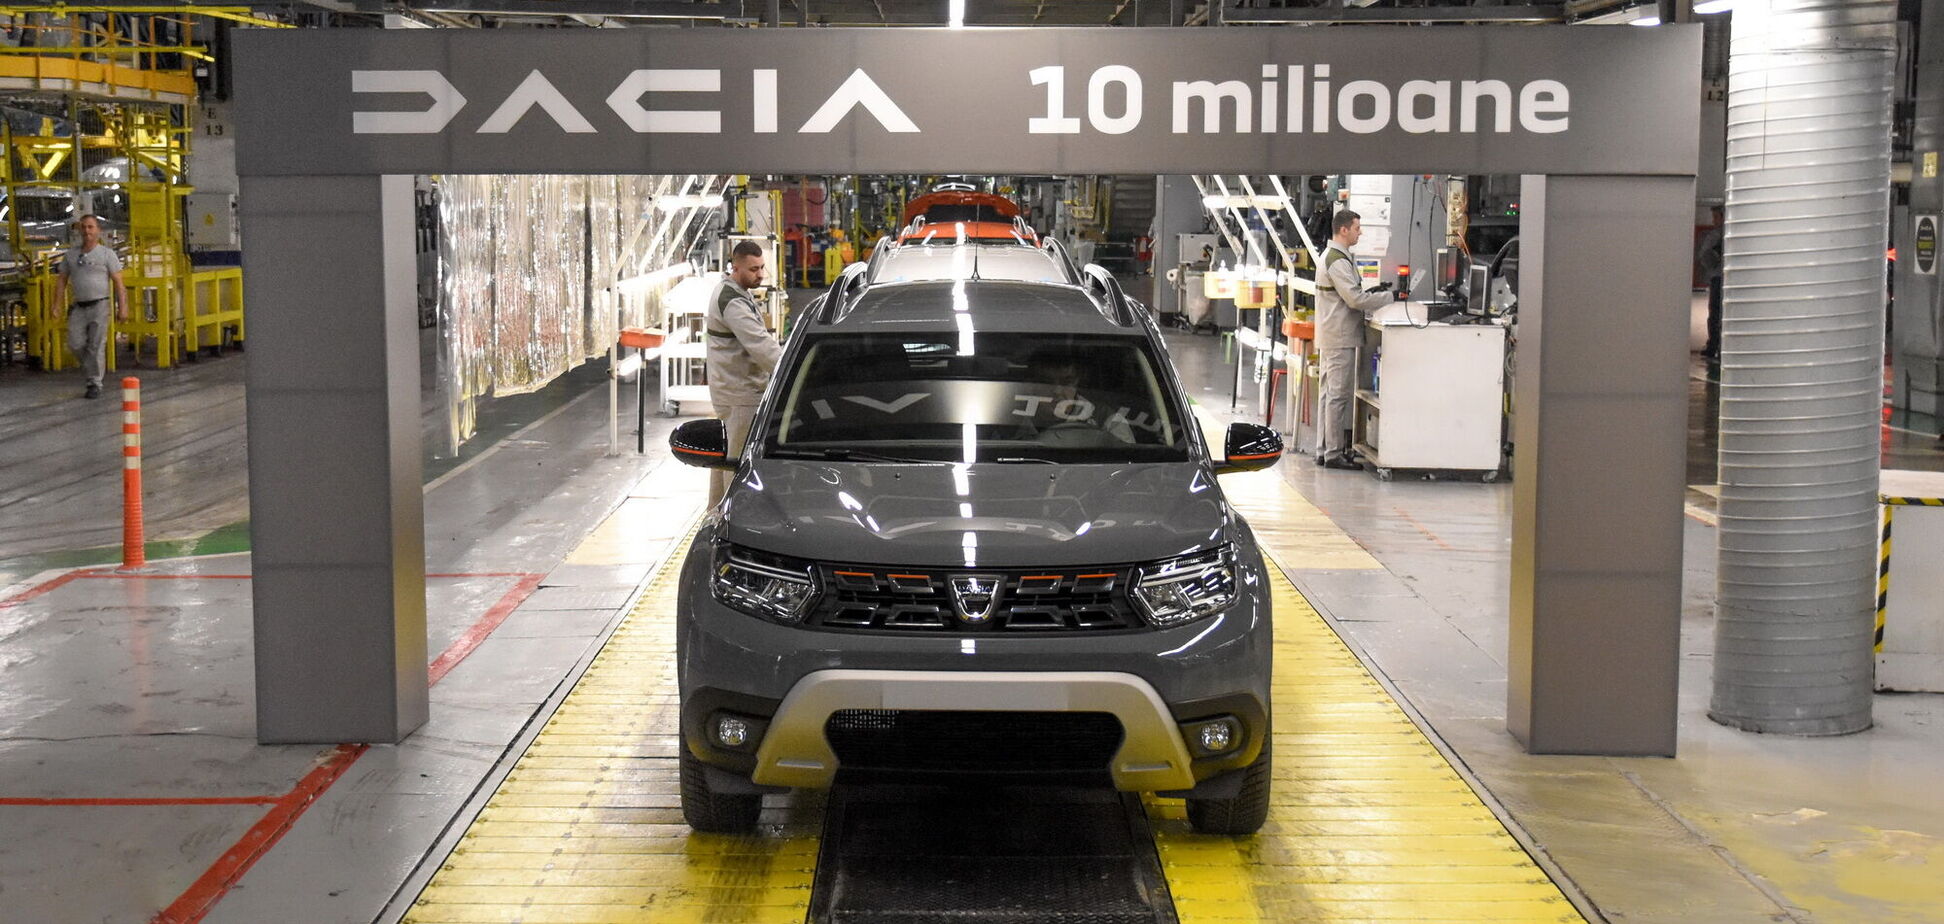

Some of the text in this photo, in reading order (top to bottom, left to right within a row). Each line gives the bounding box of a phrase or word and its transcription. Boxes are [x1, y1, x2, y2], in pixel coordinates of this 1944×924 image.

[207, 107, 217, 119] E
[352, 69, 922, 134] DACIA
[1029, 64, 1570, 135] 10 milioane
[205, 124, 223, 136] 13
